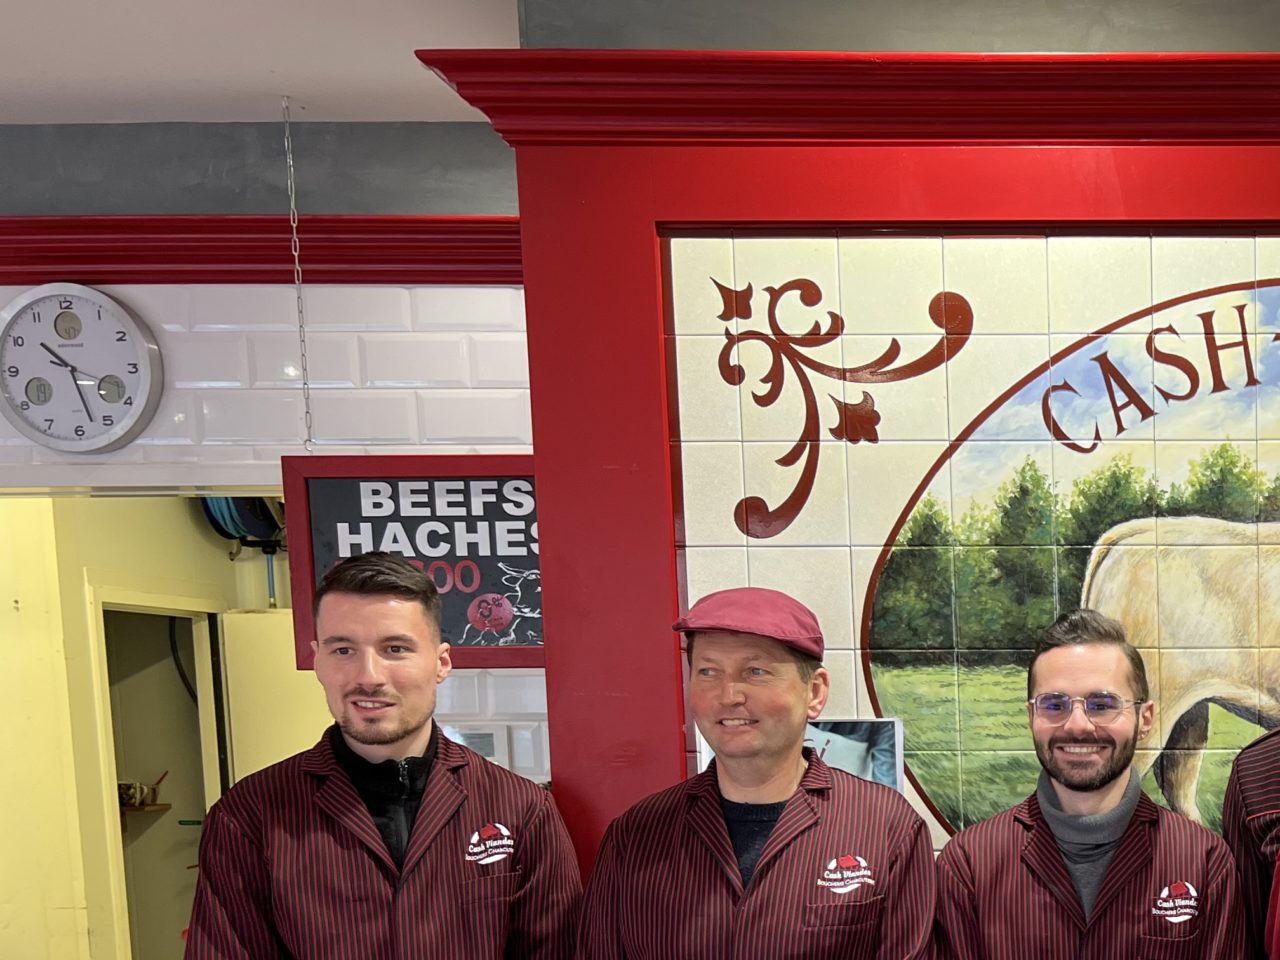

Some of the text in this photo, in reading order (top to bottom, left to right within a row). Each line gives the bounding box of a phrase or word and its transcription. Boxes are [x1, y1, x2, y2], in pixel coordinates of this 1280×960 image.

[60, 301, 72, 310] 12
[33, 312, 40, 322] 11
[13, 336, 24, 346] 10
[116, 331, 127, 342] 2
[8, 366, 19, 377] 9
[128, 363, 138, 374] 3
[21, 401, 30, 410] 8
[124, 396, 133, 406] 4
[44, 419, 54, 430] 7
[103, 416, 114, 426] 5
[74, 426, 85, 436] 6
[359, 480, 536, 517] BEEFS
[469, 837, 514, 853] Cash Viandes
[843, 869, 871, 877] Viandes
